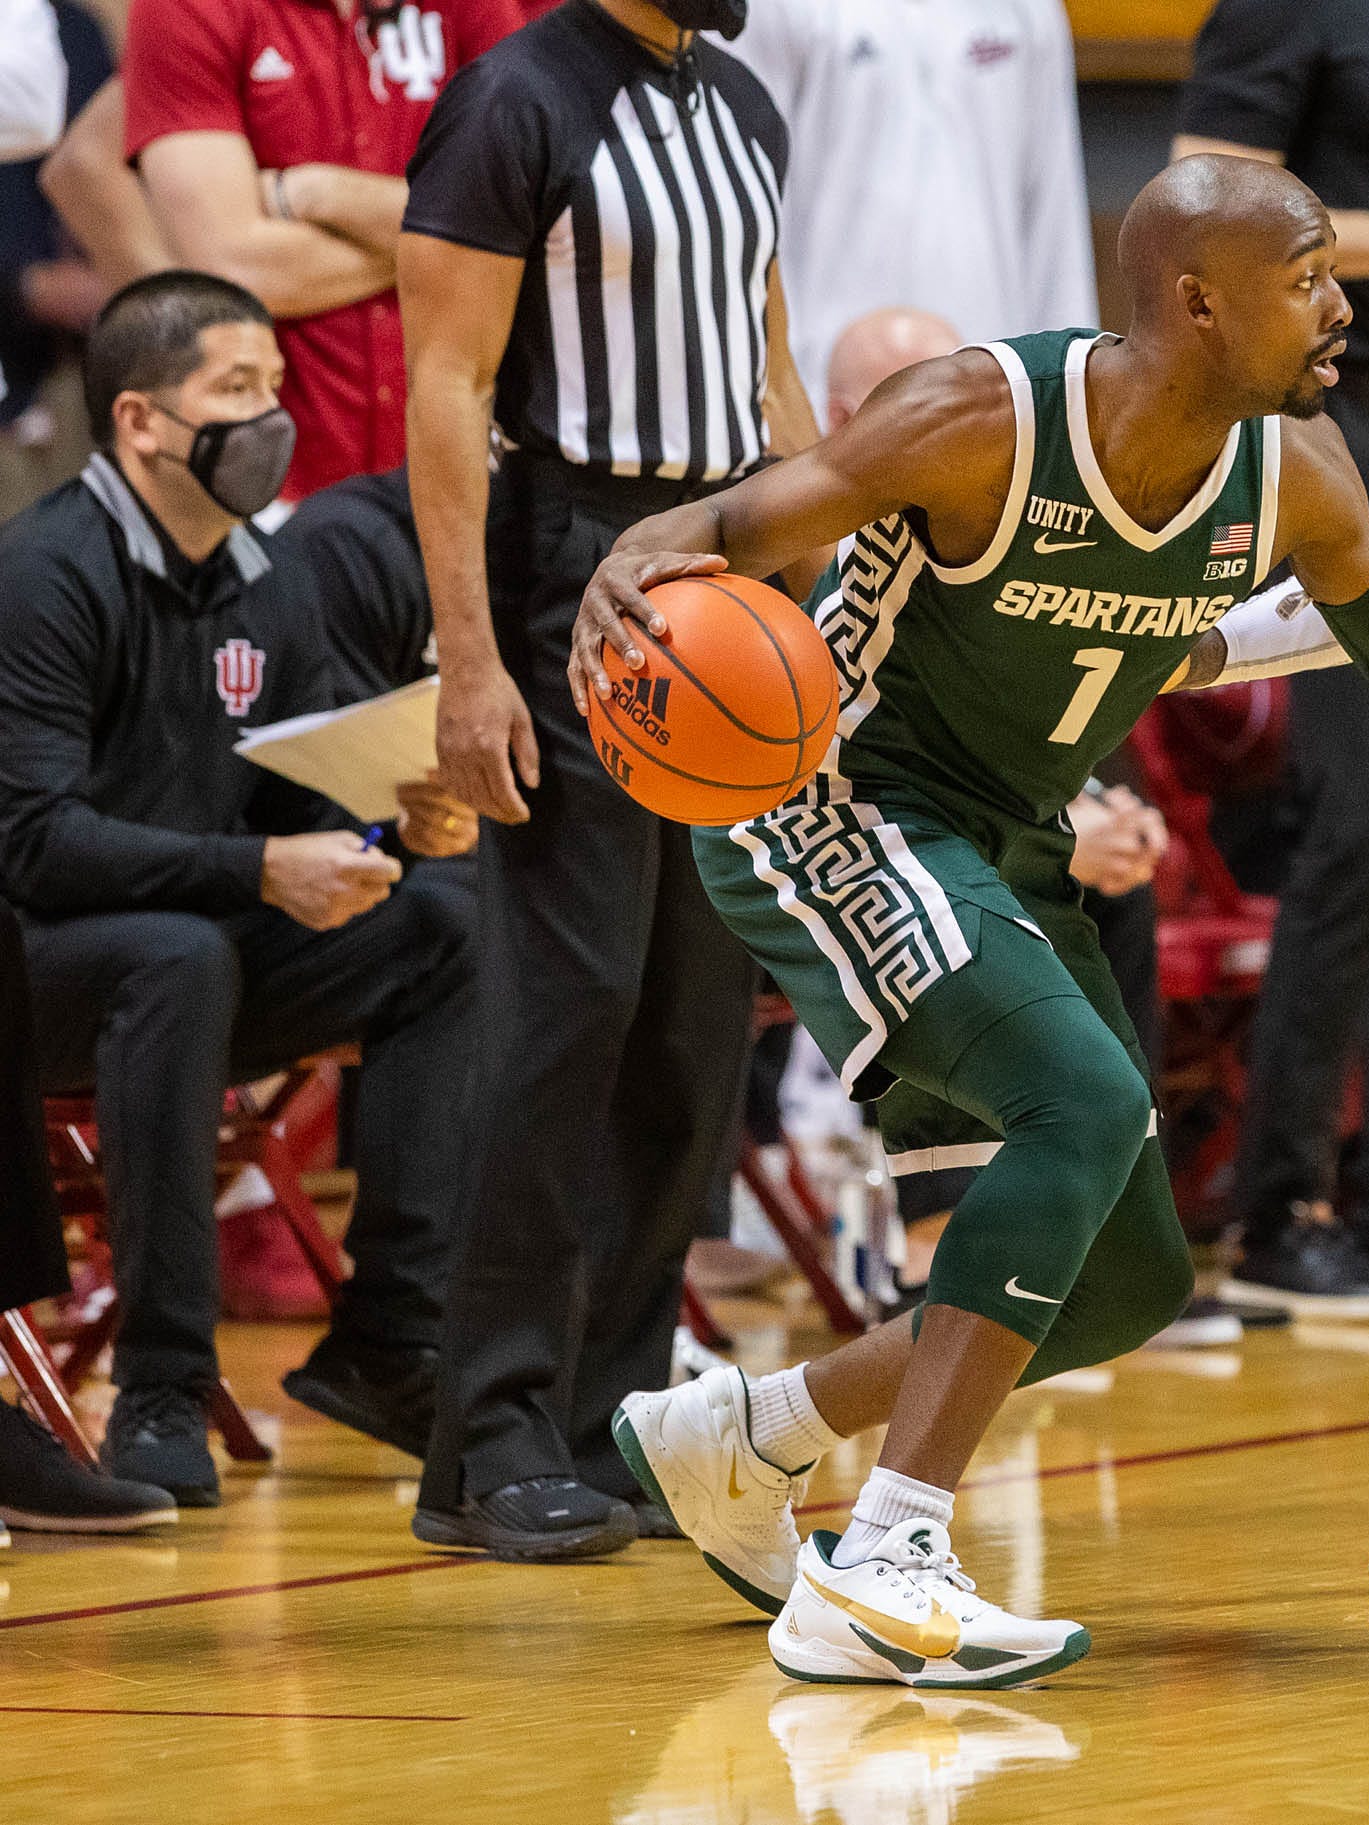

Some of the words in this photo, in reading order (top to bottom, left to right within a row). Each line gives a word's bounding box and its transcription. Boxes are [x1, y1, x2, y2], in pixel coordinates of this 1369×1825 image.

[1027, 495, 1094, 536] UNITY
[993, 580, 1235, 638] SPARTANS
[1047, 647, 1125, 745] 1
